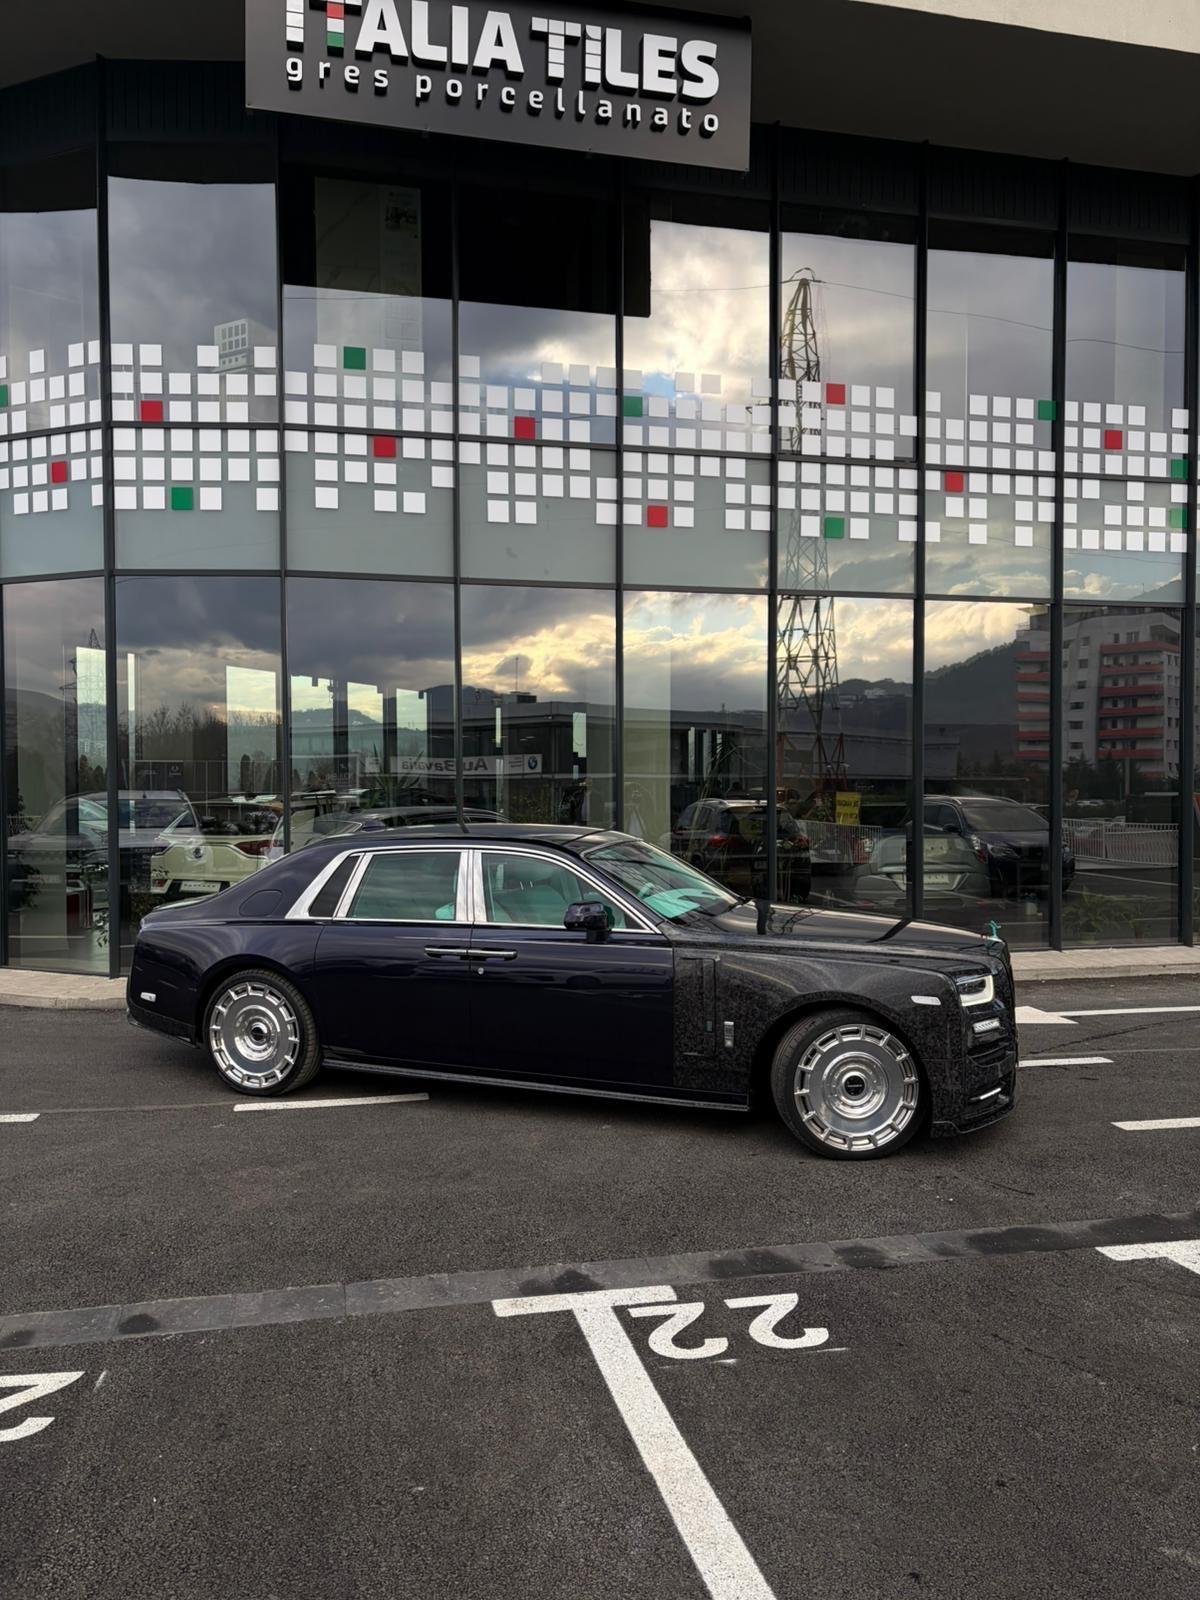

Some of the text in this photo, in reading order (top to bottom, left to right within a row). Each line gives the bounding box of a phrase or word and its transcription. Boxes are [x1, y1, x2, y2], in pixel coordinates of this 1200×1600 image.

[285, 0, 720, 99] ITALIA TILES
[286, 57, 719, 132] gres porcellanato
[627, 1292, 830, 1360] 22
